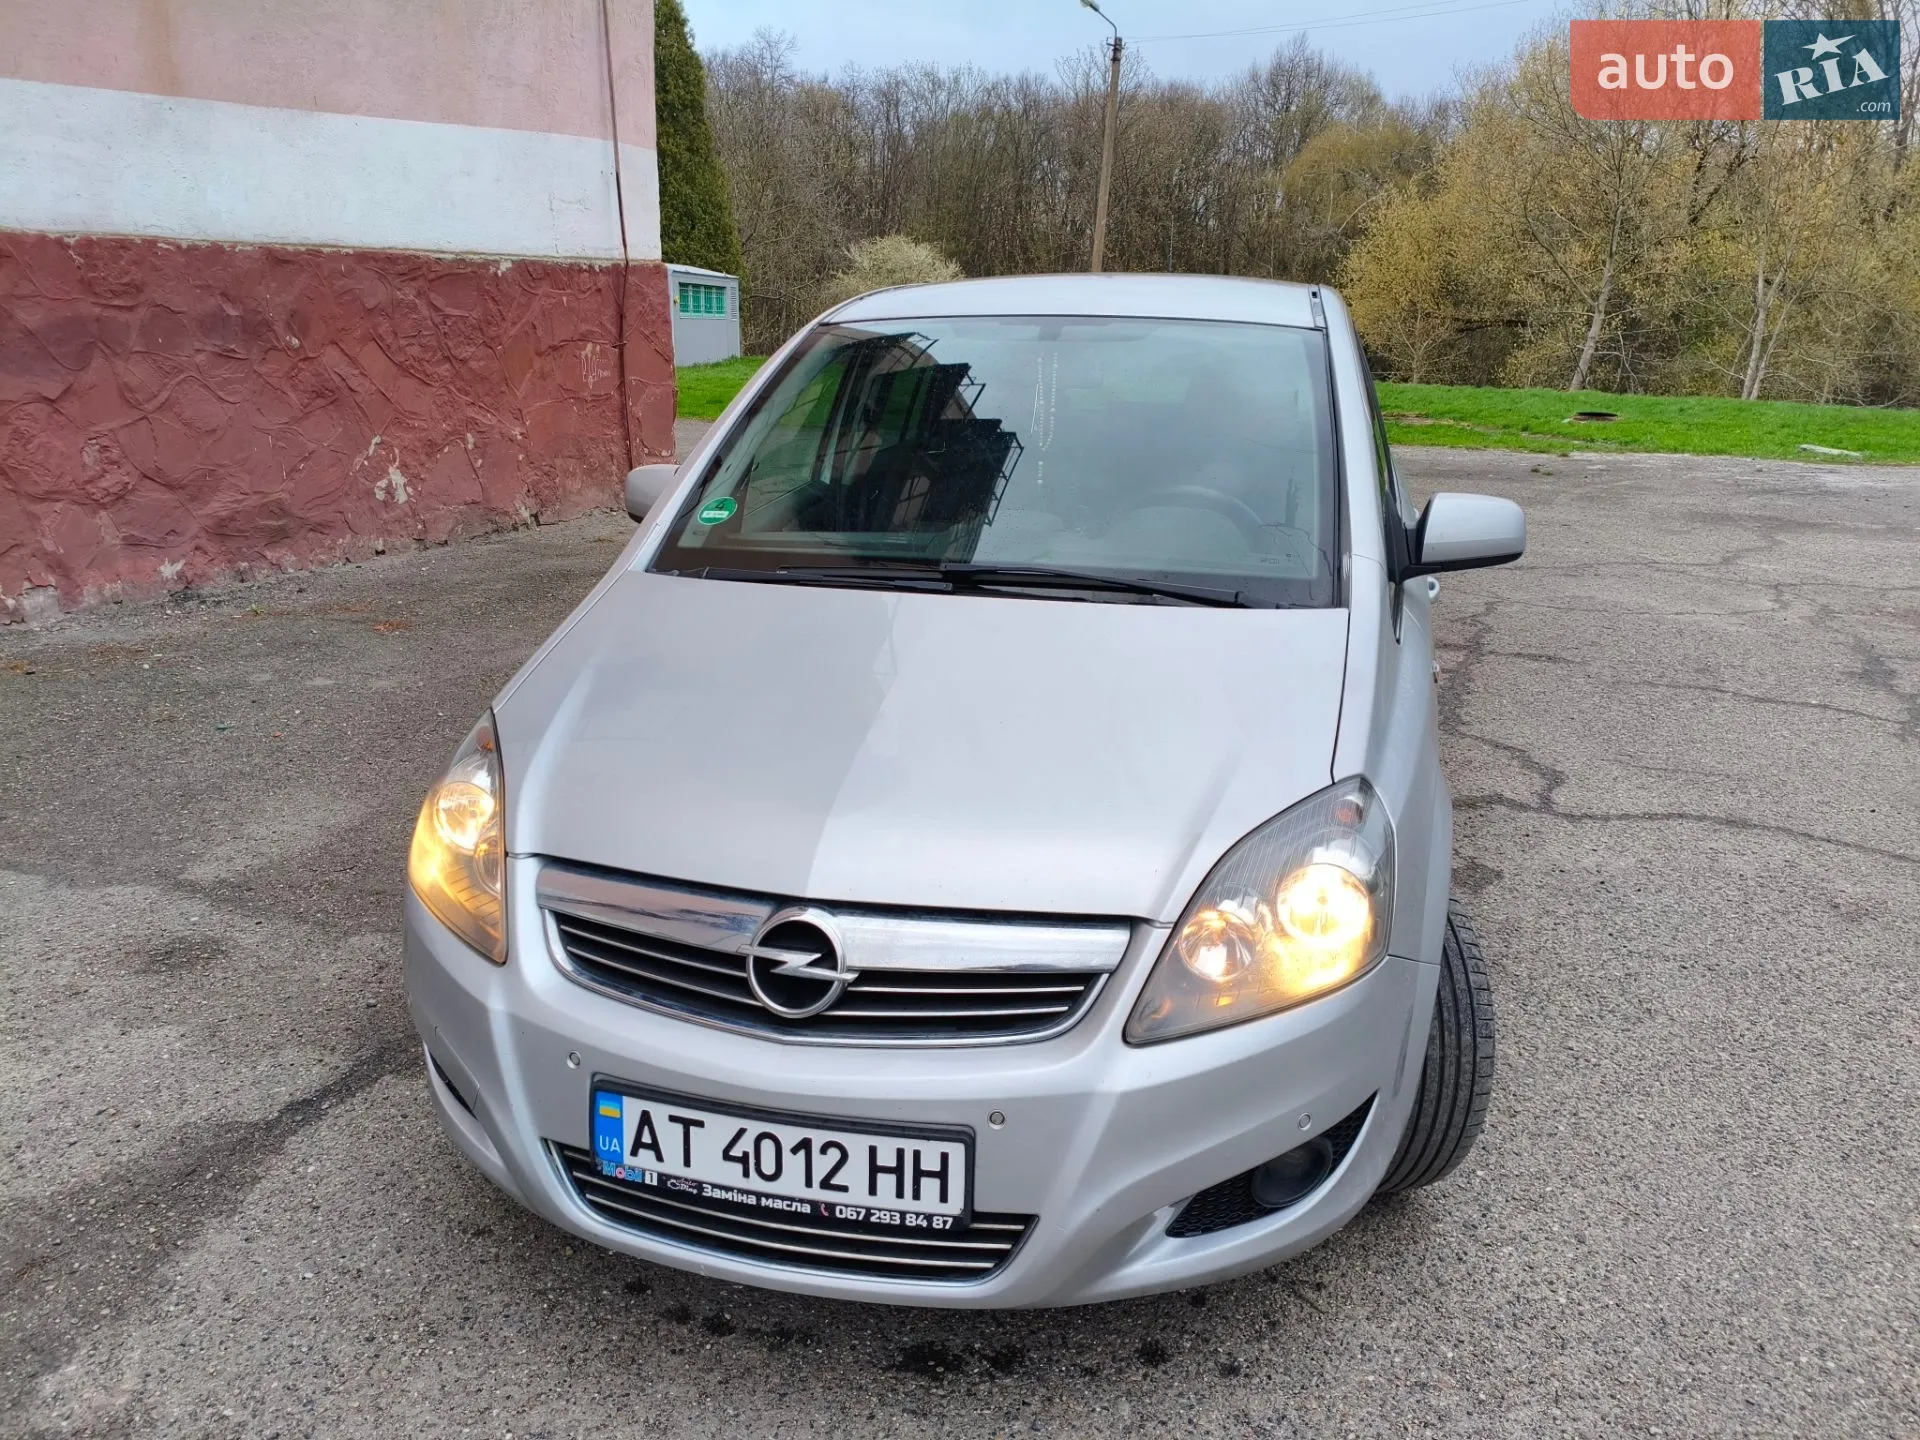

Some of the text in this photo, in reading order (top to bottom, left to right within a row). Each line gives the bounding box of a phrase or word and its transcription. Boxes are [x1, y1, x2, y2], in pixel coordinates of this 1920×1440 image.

[715, 499, 727, 511] 4
[599, 1135, 621, 1153] UA
[629, 1109, 949, 1204] AT 4012 HH
[602, 1162, 643, 1183] Mobil
[702, 1184, 811, 1213] Заміна масла
[835, 1205, 953, 1230] 067 293 84 87
